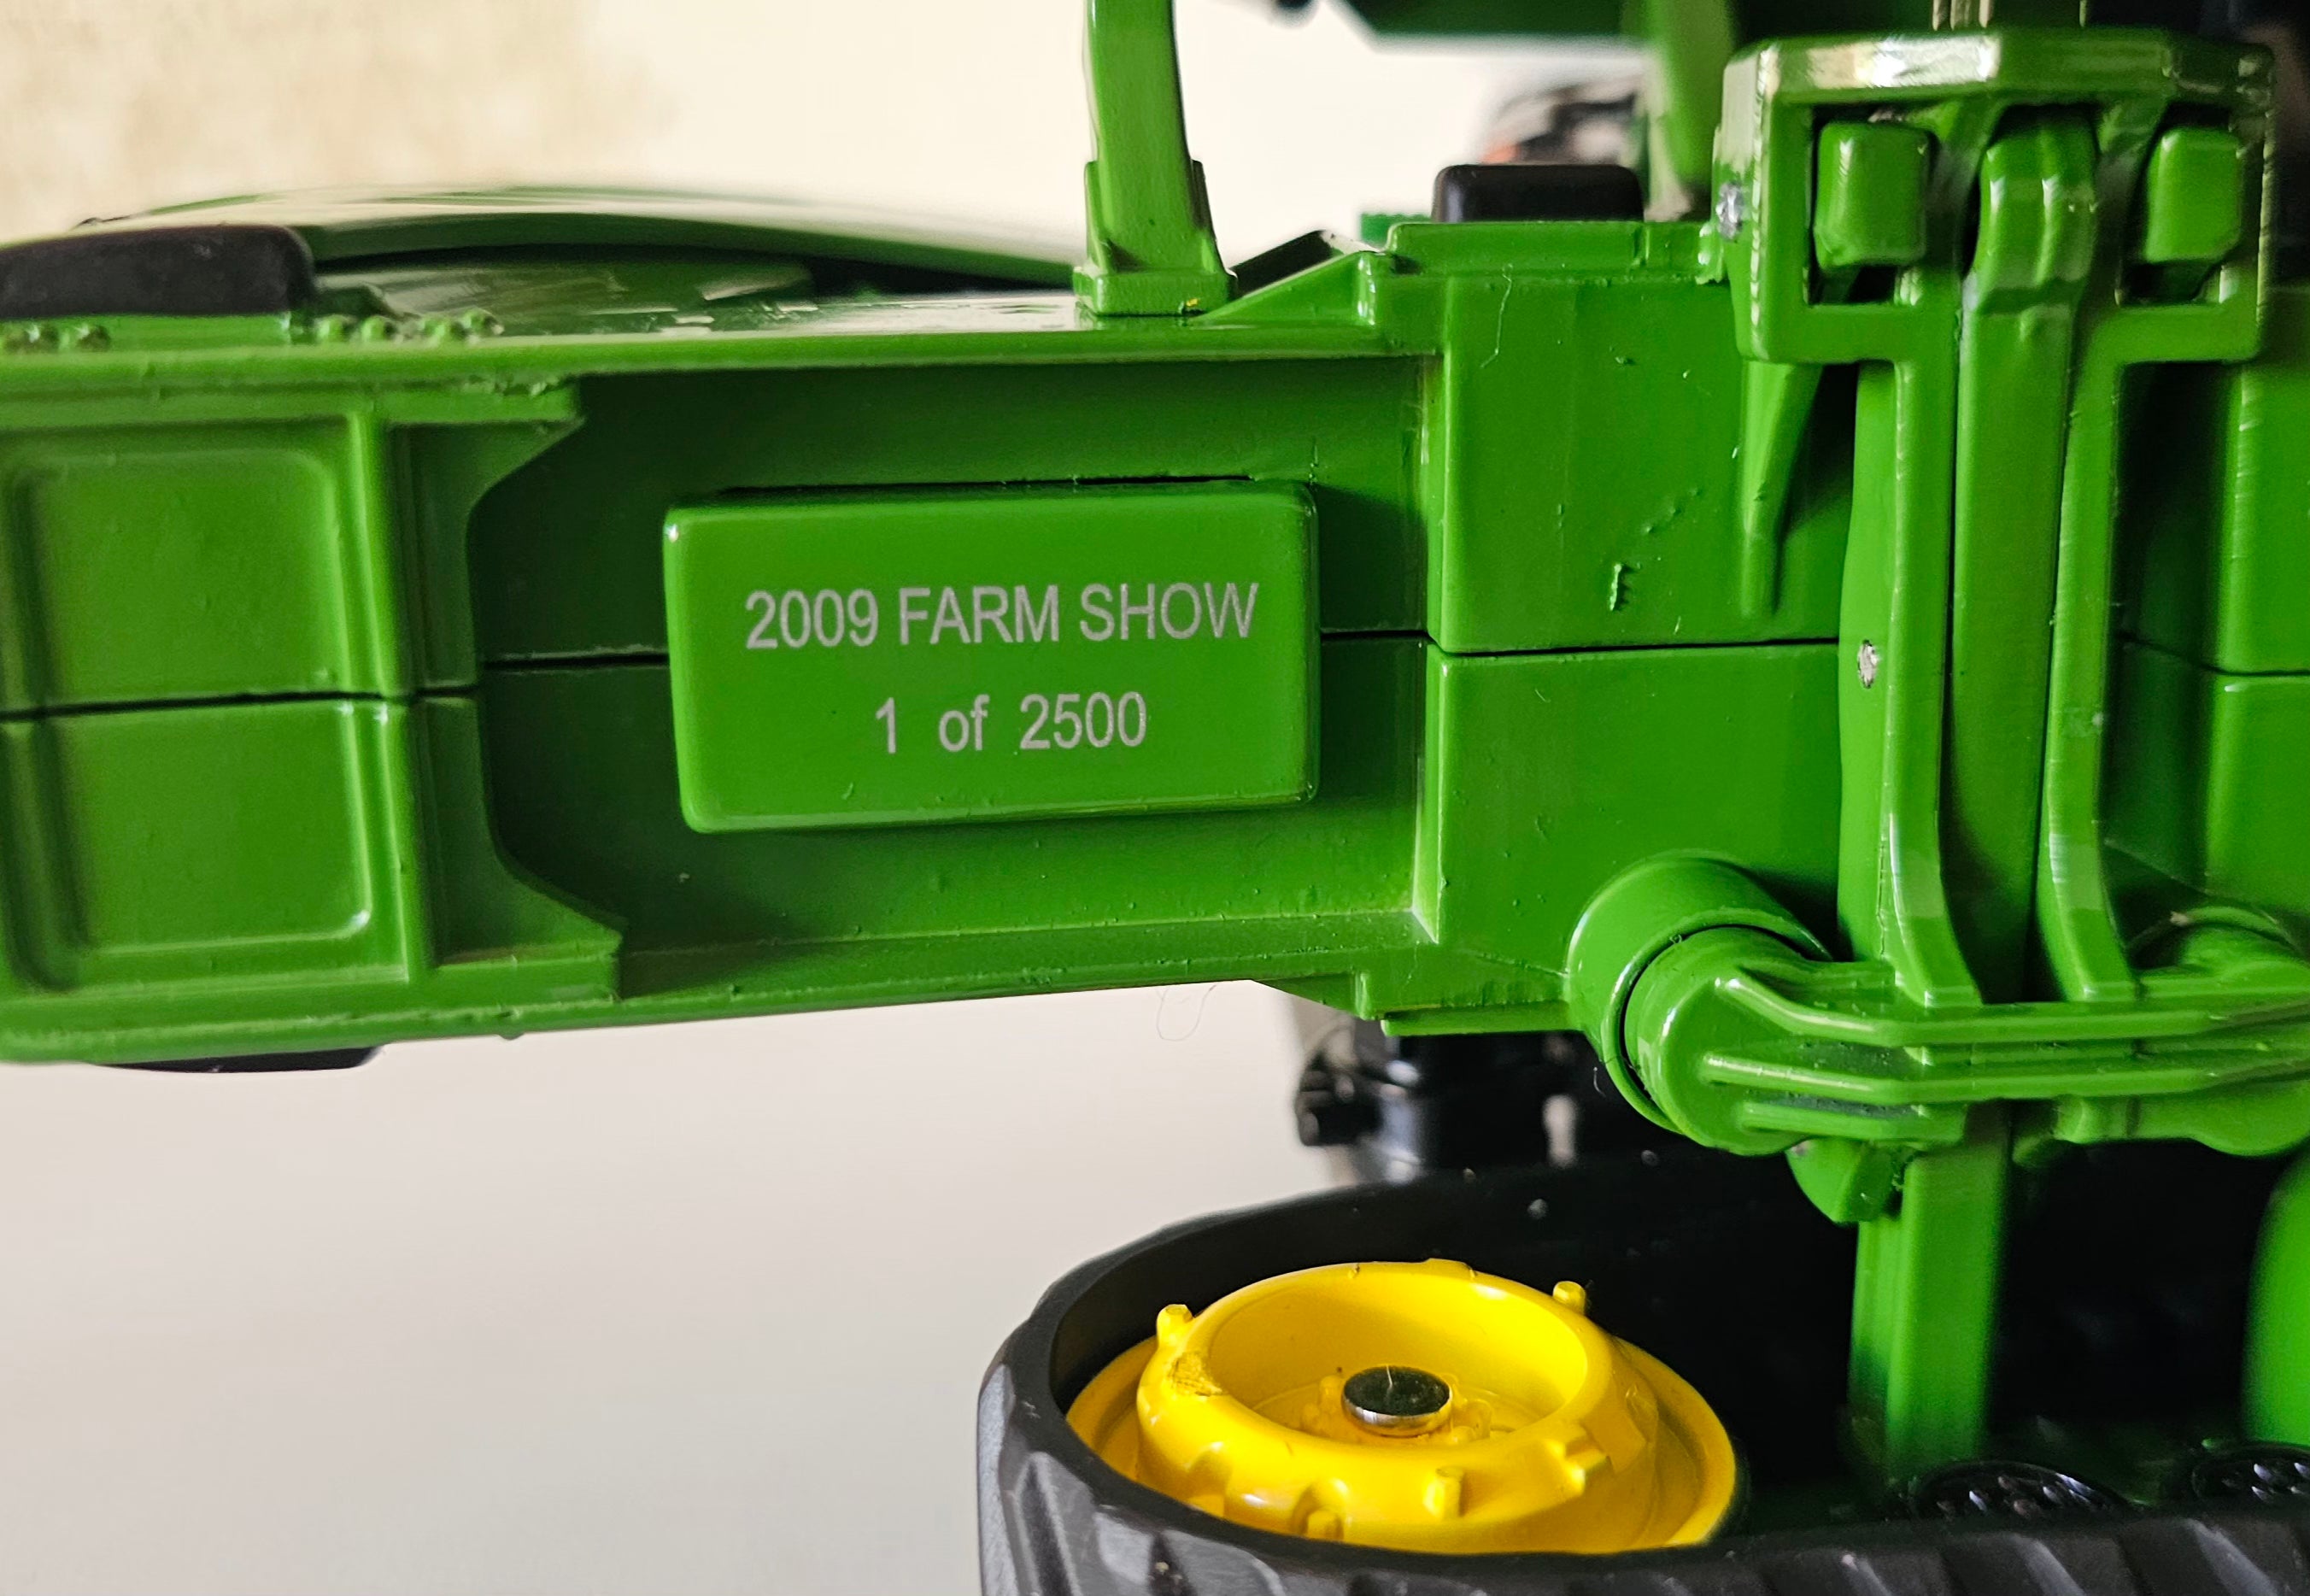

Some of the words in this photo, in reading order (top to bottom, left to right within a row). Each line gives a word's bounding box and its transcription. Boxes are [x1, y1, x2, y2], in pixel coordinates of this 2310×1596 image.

[745, 588, 879, 650] 2009
[899, 584, 1060, 646] FARM
[1079, 582, 1259, 643] SHOW
[875, 696, 897, 754] 1
[938, 693, 991, 753] of
[1019, 690, 1147, 750] 2500
